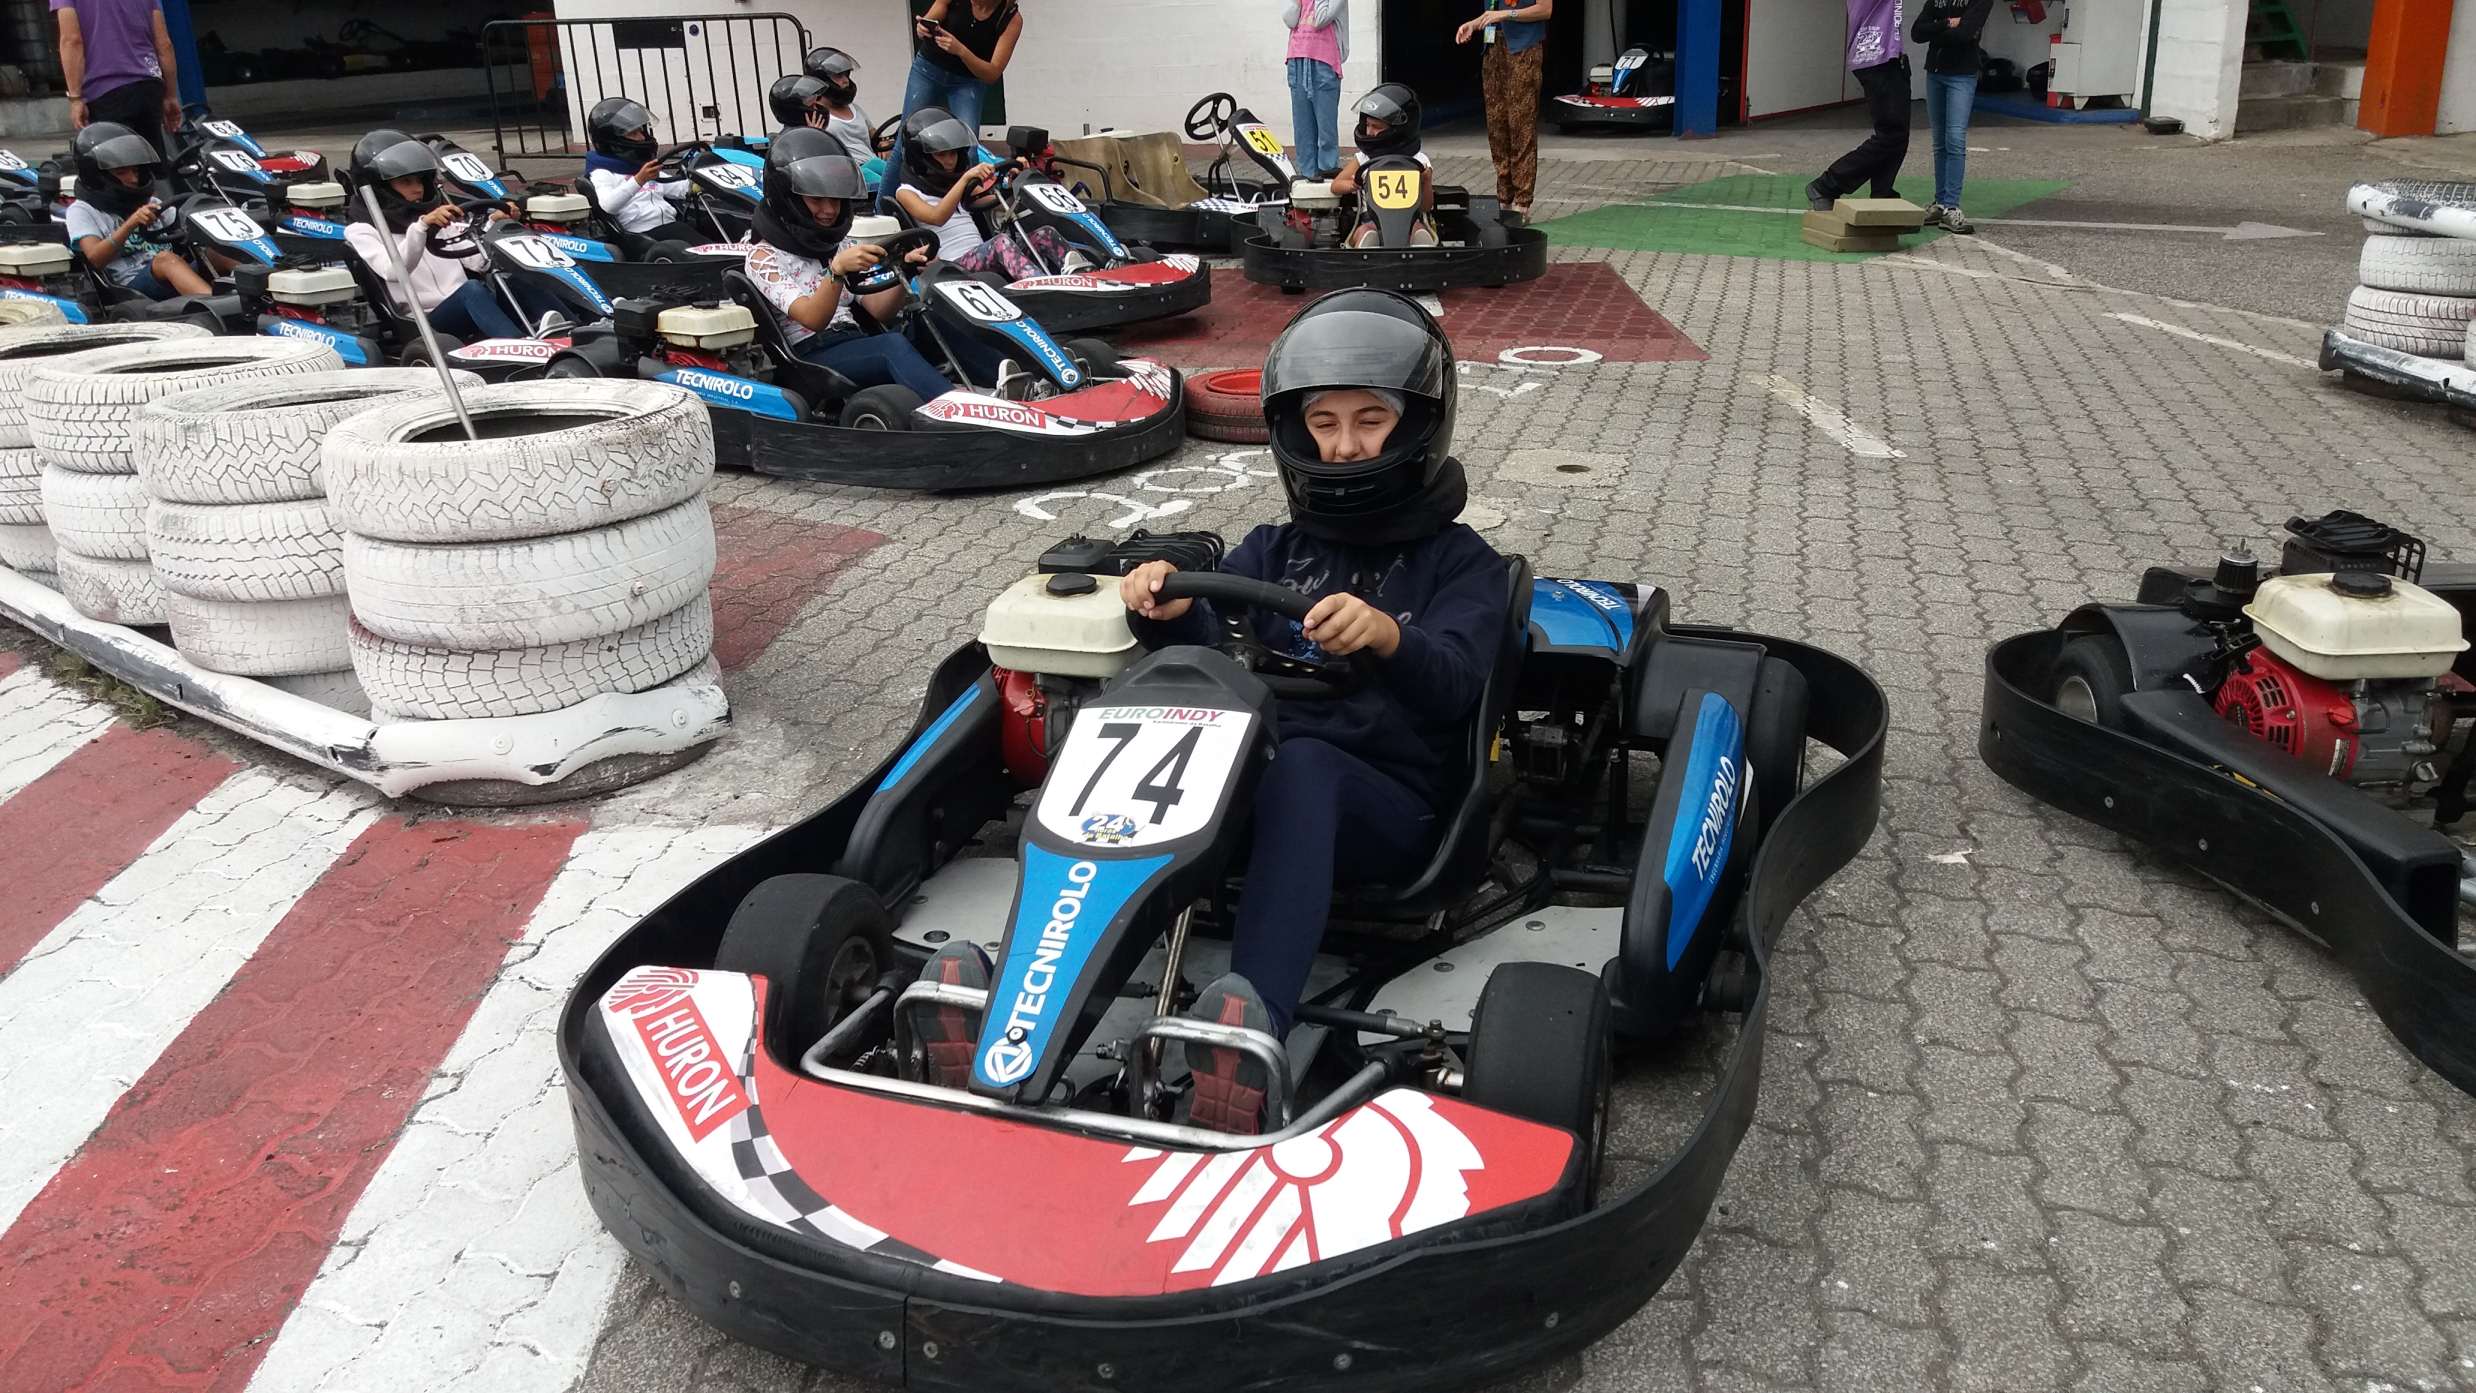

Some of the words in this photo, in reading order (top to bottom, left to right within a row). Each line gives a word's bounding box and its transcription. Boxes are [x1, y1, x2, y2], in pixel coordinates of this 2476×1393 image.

[1249, 130, 1277, 152] 51
[220, 153, 256, 168] 76
[452, 157, 486, 177] 70
[709, 167, 745, 185] 64
[1378, 175, 1408, 199] 54
[1039, 187, 1077, 207] 66
[205, 212, 253, 236] 75
[292, 217, 334, 235] TECNIROLO
[510, 238, 565, 262] 72
[1041, 278, 1092, 287] HURON
[958, 285, 1007, 316] 67
[279, 322, 335, 348] TECNIROLO
[1016, 320, 1066, 371] TECNIROLO
[675, 369, 754, 400] TECNIROLO
[969, 404, 1039, 426] HURON
[1098, 708, 1224, 722] EUROINDY
[1069, 723, 1204, 825] 74
[1692, 756, 1736, 881] TECNIROLO
[1012, 861, 1097, 1033] TECNIROLO
[646, 1009, 736, 1126] HURON
